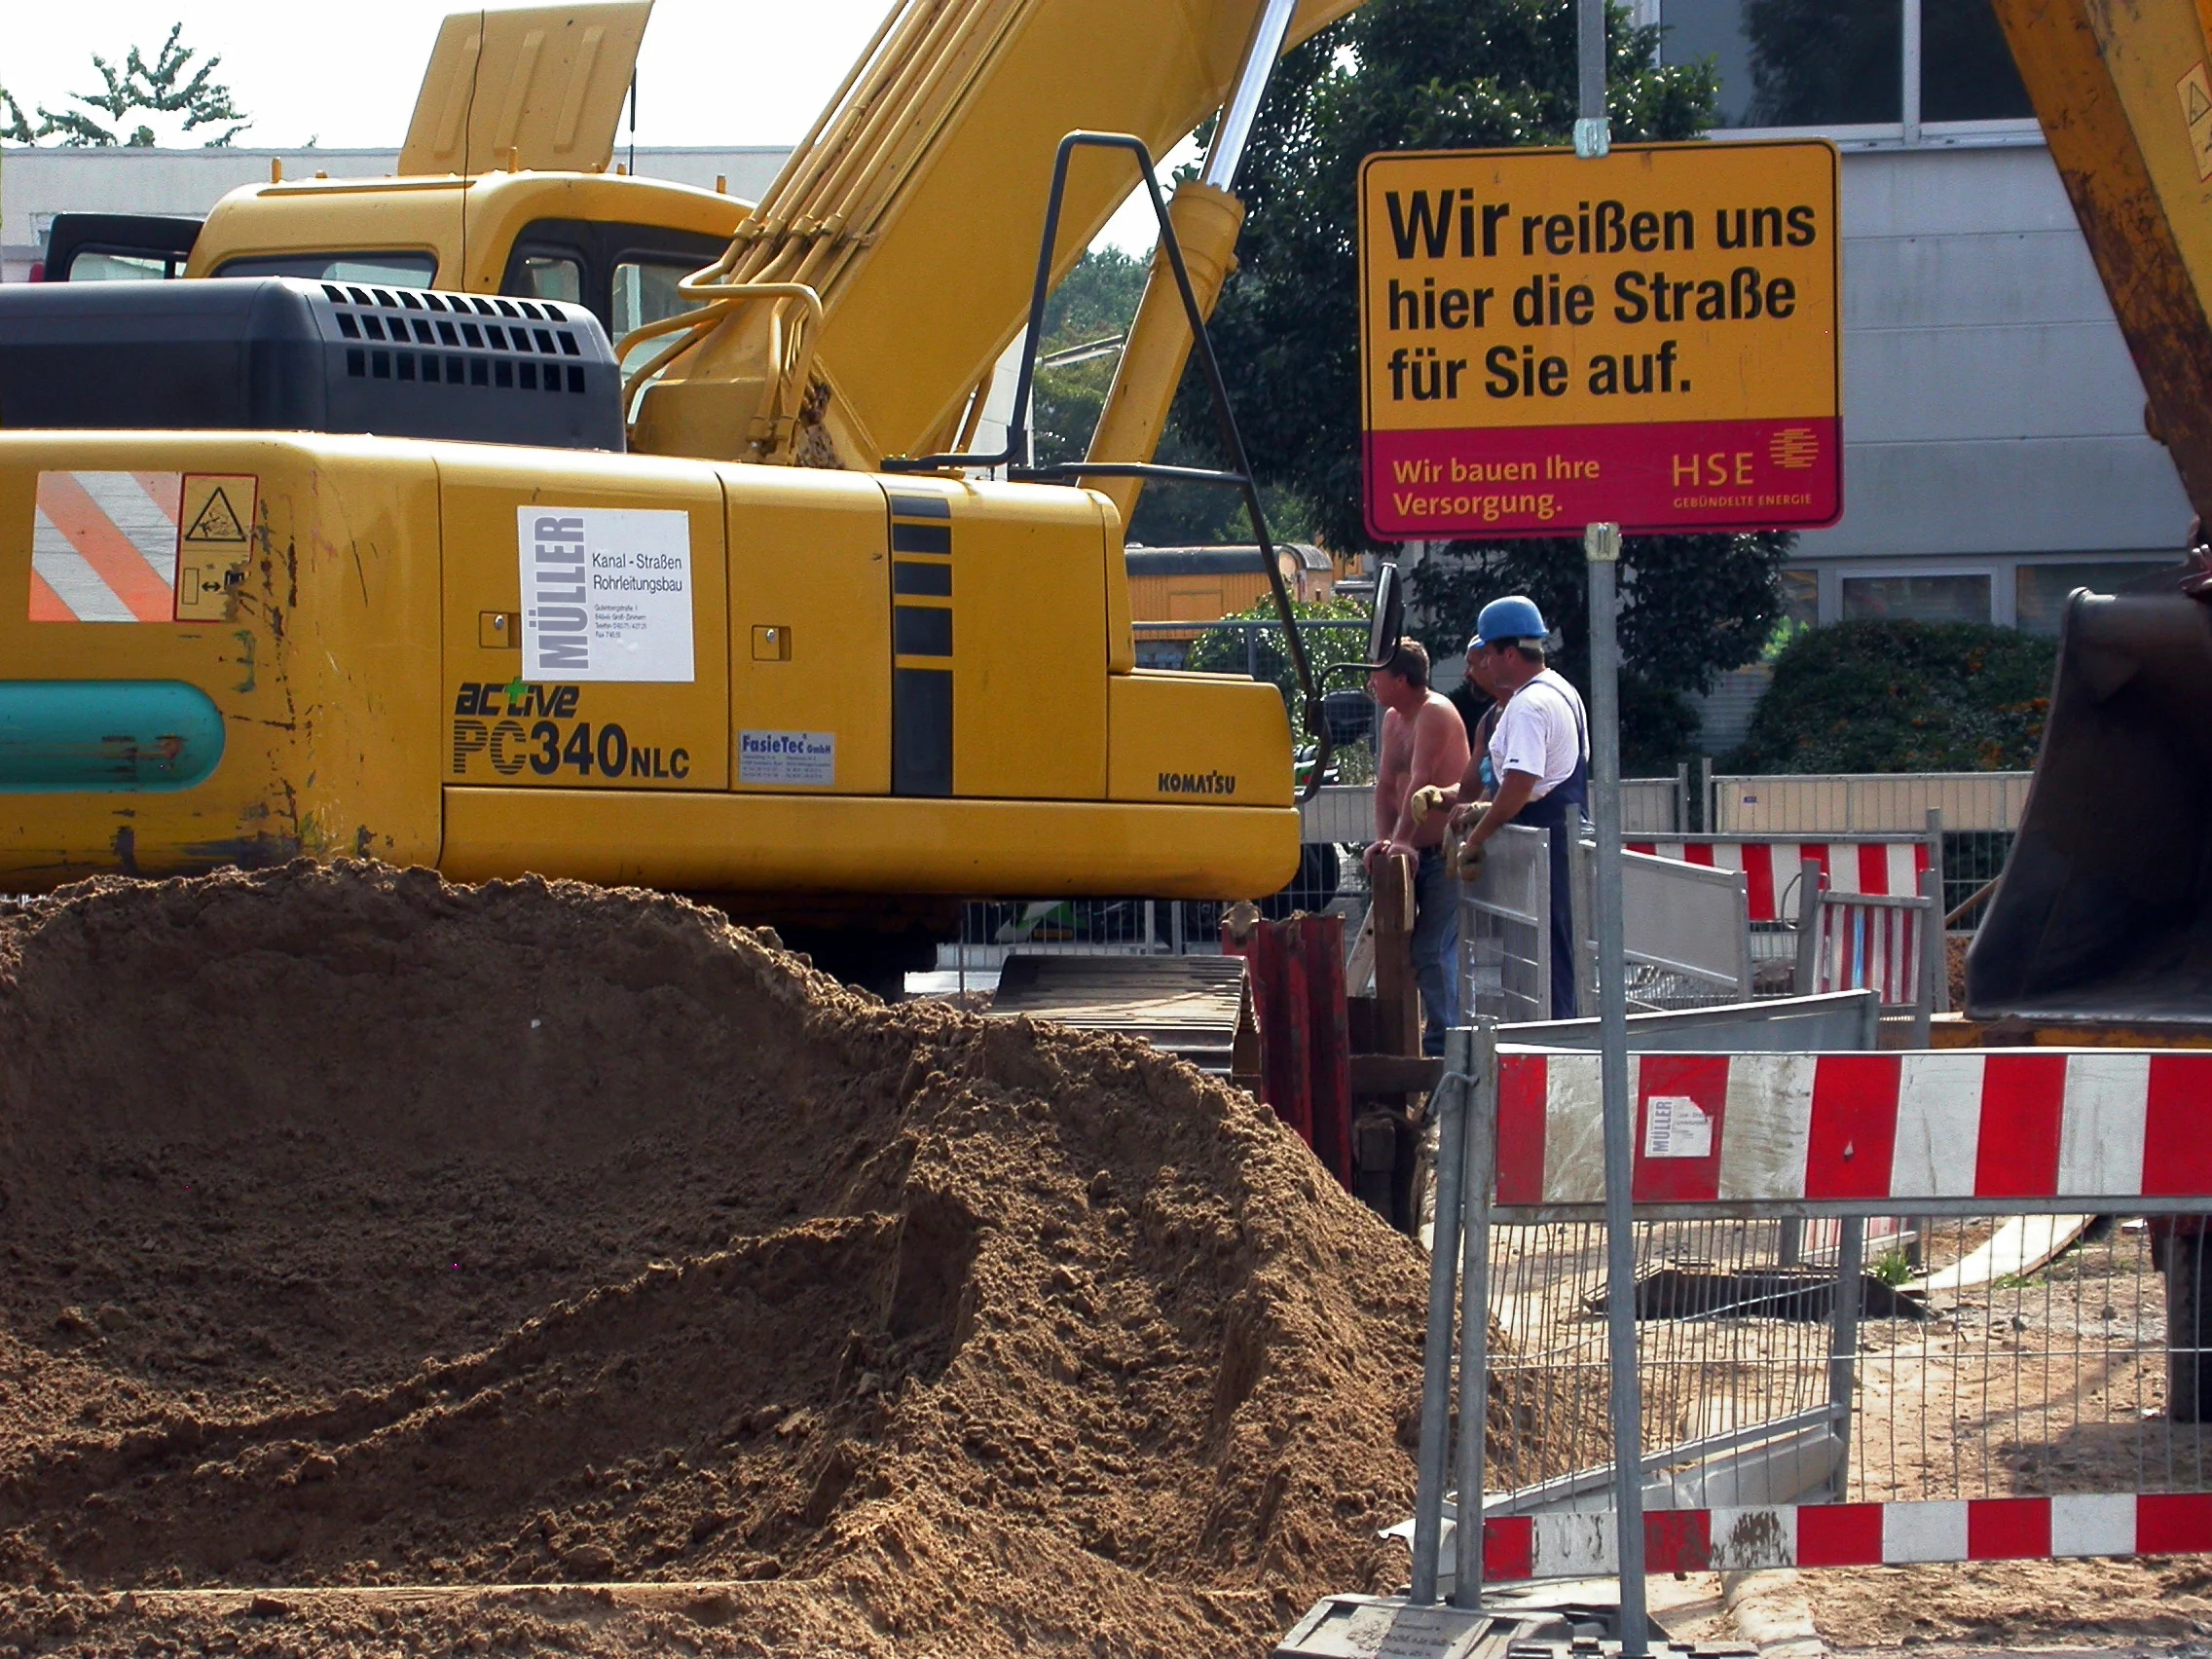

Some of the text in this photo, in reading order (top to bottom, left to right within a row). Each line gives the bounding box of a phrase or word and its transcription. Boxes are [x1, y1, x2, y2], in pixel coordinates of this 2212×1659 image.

[1385, 188, 1816, 259] Wir reißen uns
[1388, 266, 1796, 330] hier die Straße
[1387, 340, 1691, 401] für Sie auf.
[1393, 454, 1600, 484] Wir bauen Ihre
[1673, 452, 1754, 487] HSE
[1393, 492, 1563, 522] Versorgung.
[1673, 494, 1812, 509] GEBÜNDELTE ENERGIE
[592, 553, 626, 569] Kanal
[636, 553, 682, 570] Straßen
[529, 517, 589, 669] MÜLLER
[593, 574, 682, 594] Rohrleitungsbau
[455, 677, 580, 719] active
[1158, 770, 1235, 794] KOMATSU
[1650, 1100, 1673, 1153] MÜLLER
